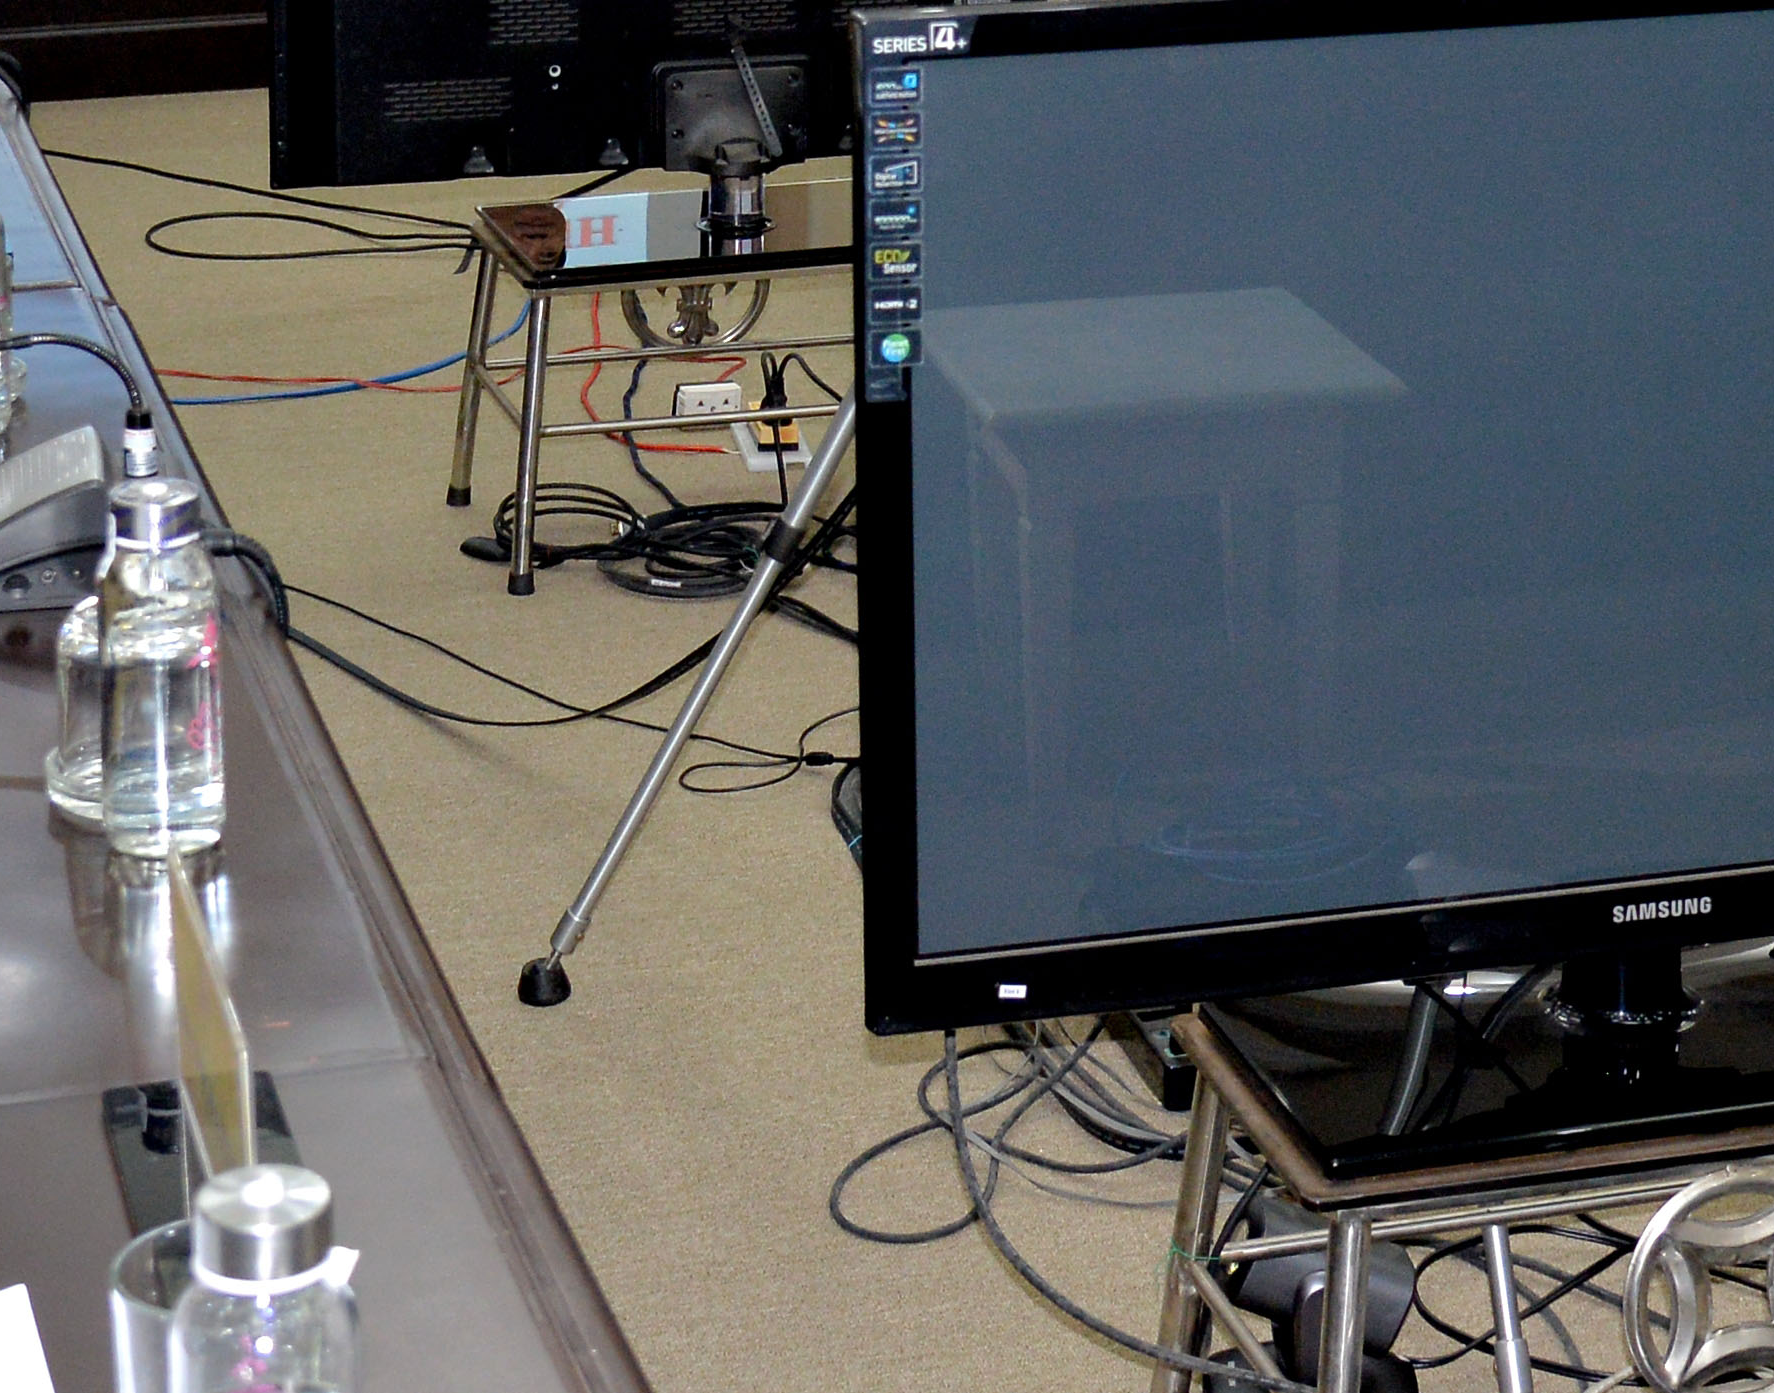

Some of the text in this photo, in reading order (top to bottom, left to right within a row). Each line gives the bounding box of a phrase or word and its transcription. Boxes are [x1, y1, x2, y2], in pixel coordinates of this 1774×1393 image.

[873, 36, 926, 54] SERIES
[874, 249, 903, 264] ECO
[883, 263, 917, 275] Sensor
[1612, 896, 1712, 923] SAMSUNG
